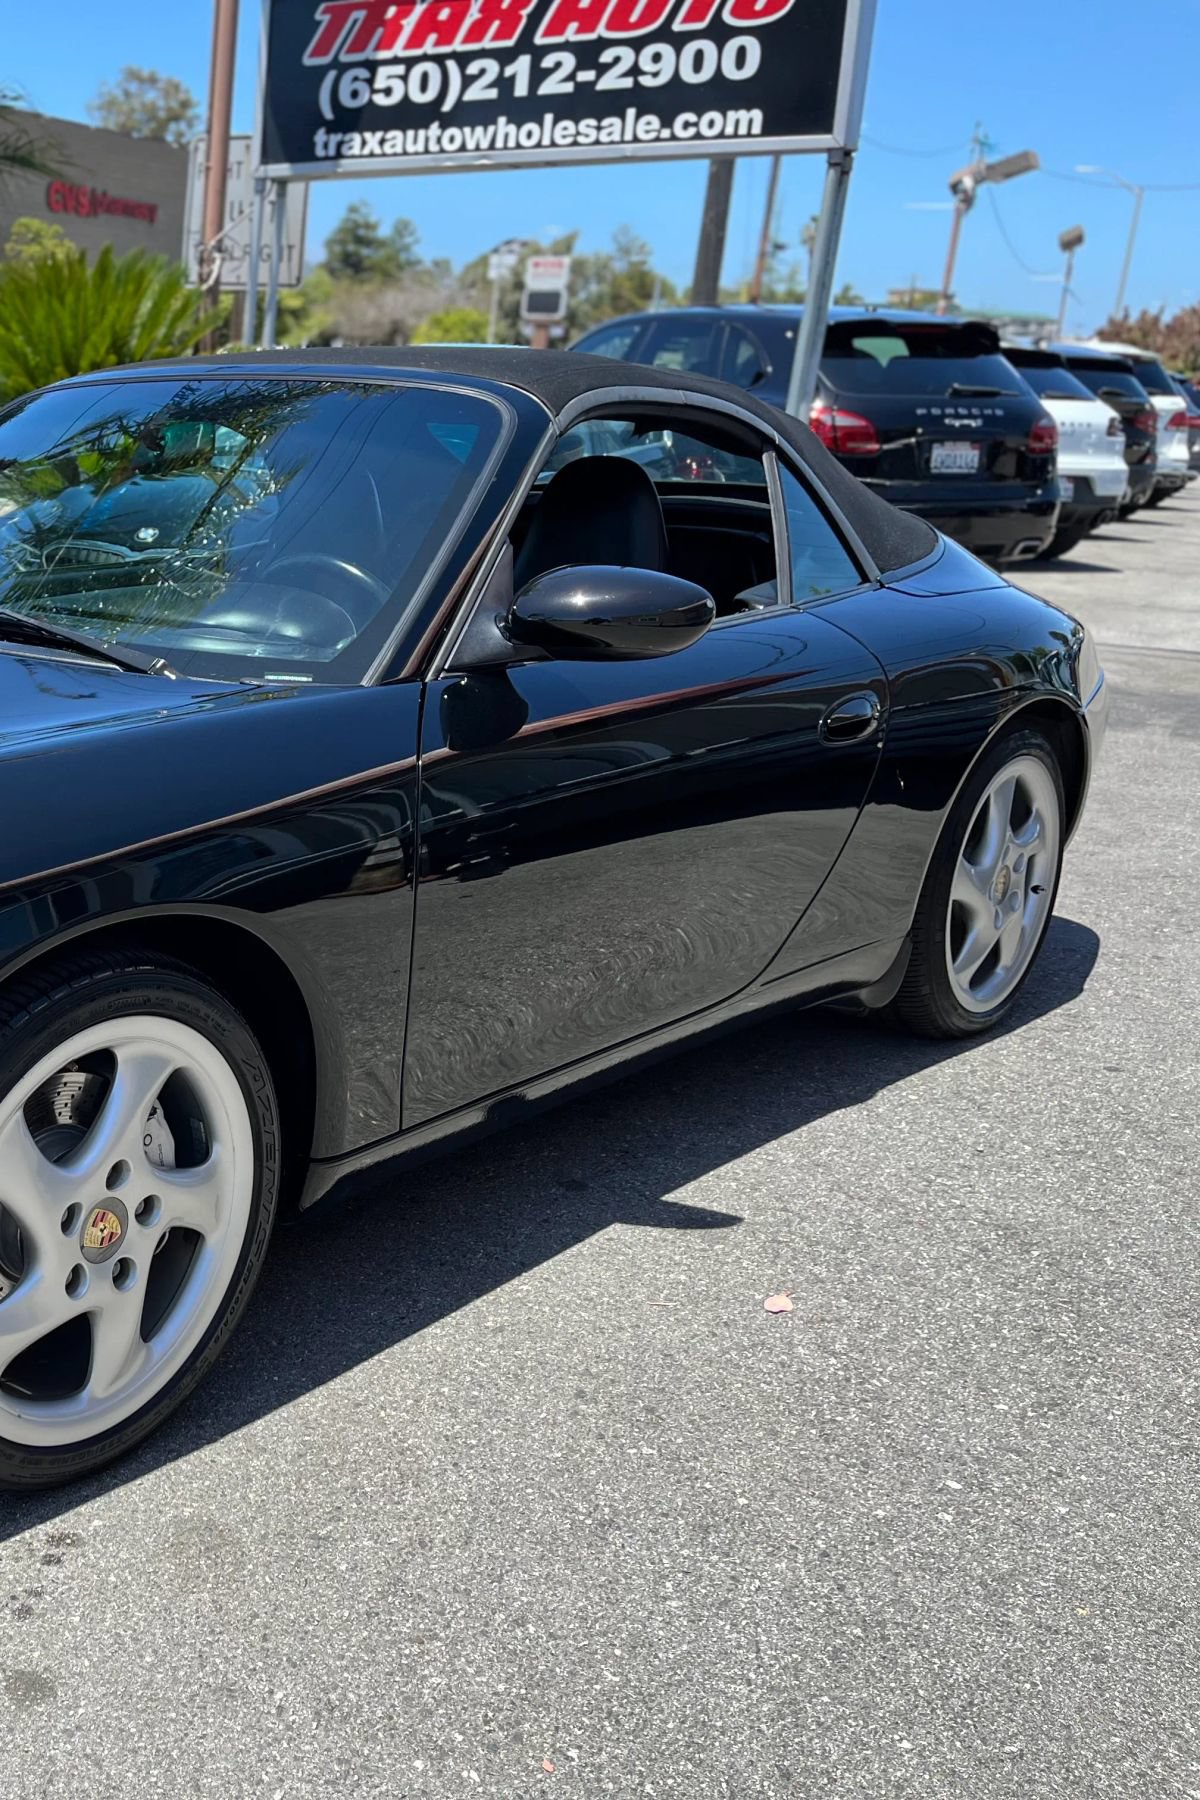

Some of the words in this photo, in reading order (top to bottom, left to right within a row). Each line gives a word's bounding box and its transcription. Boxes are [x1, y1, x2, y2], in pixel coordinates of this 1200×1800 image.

[302, 0, 538, 66] TRAX
[318, 36, 762, 120] (650)212-2900
[313, 108, 763, 158] traxautowholesale.com
